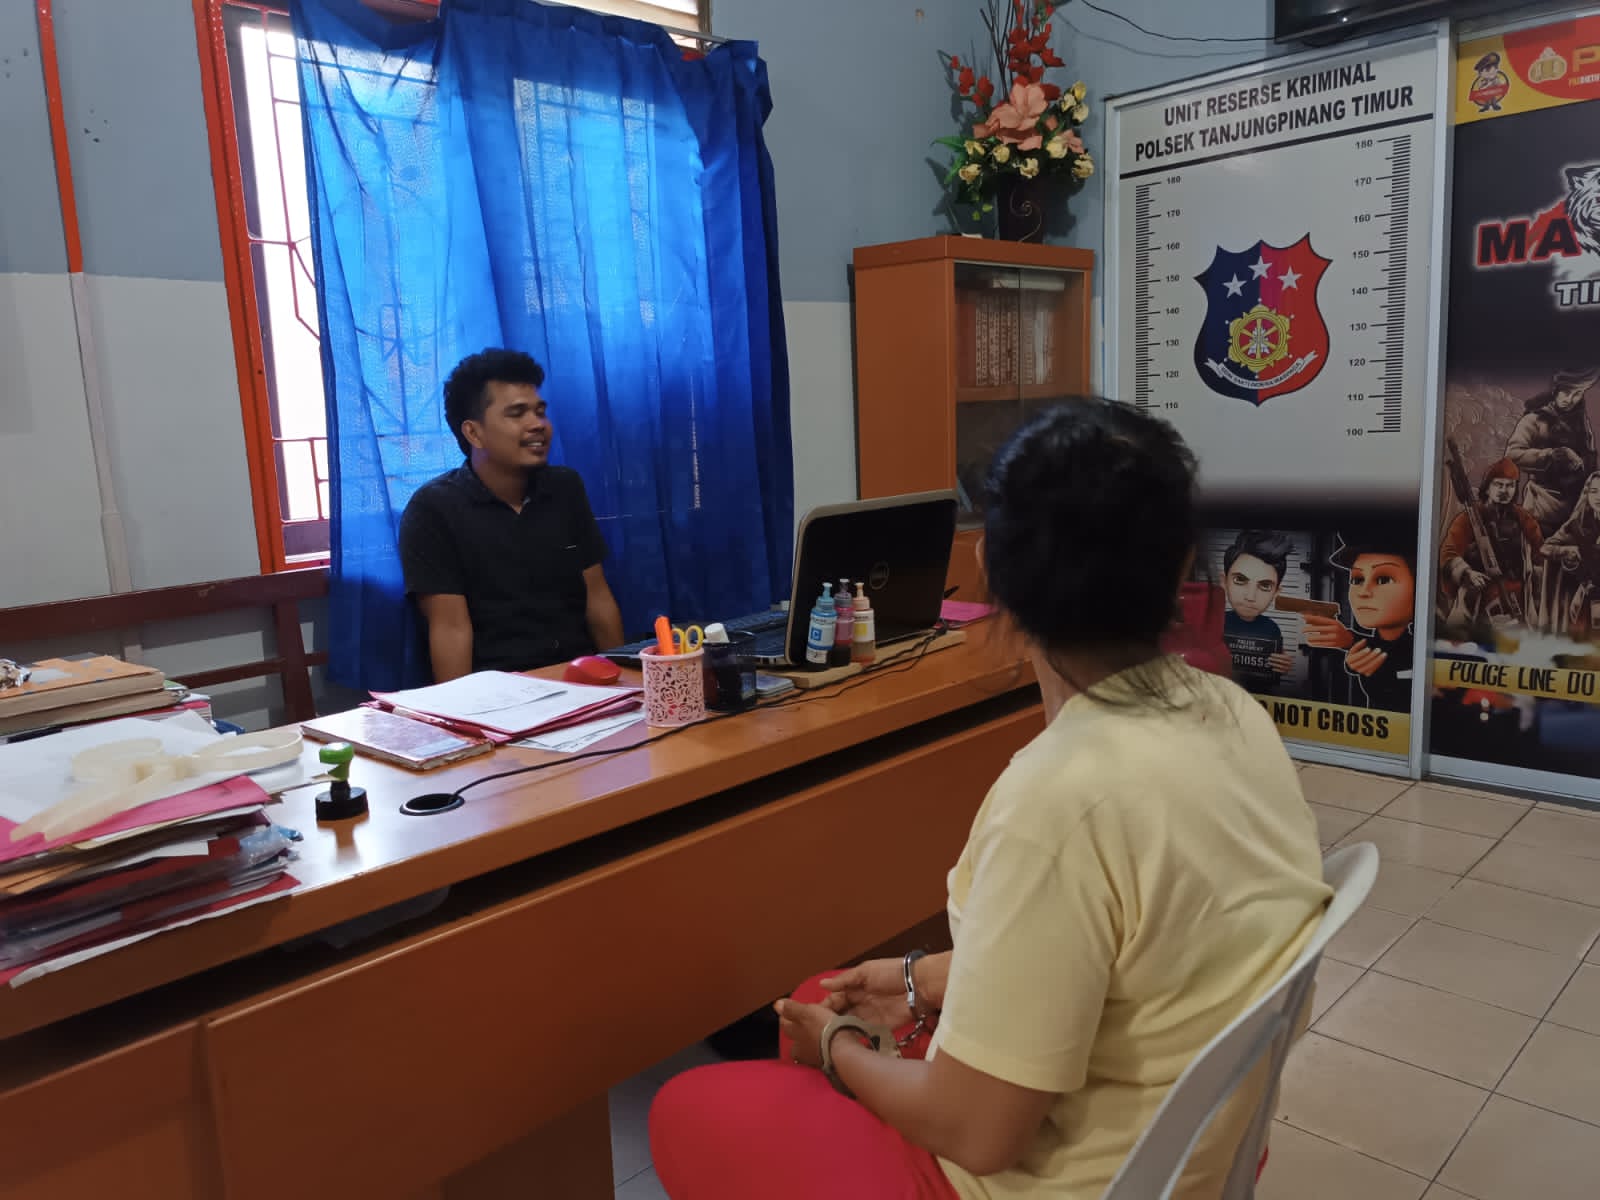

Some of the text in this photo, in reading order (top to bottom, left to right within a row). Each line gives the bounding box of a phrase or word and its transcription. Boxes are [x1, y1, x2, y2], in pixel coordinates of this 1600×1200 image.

[1164, 61, 1376, 126] UNIT RESERSE KRIMINAL
[1135, 85, 1413, 161] POLSEK TANJUNGPINANG TIMUR
[1355, 139, 1374, 150] 180
[1166, 175, 1181, 185] 180
[1354, 176, 1373, 187] 170
[1166, 209, 1181, 218] 170
[1354, 213, 1371, 224] 160
[1166, 241, 1181, 251] 160
[1352, 249, 1370, 260] 150
[1166, 274, 1180, 283] 150
[1351, 286, 1368, 296] 140
[1165, 306, 1180, 315] 140
[1350, 322, 1367, 332] 130
[1165, 339, 1180, 348] 130
[1349, 357, 1366, 367] 120
[1165, 370, 1179, 379] 120
[1347, 393, 1364, 402] 110
[1165, 402, 1179, 410] 110
[1346, 427, 1364, 437] 100
[1449, 661, 1596, 697] POLICE LINE DO
[1273, 702, 1313, 728] NOT
[1317, 708, 1389, 739] CROSS
